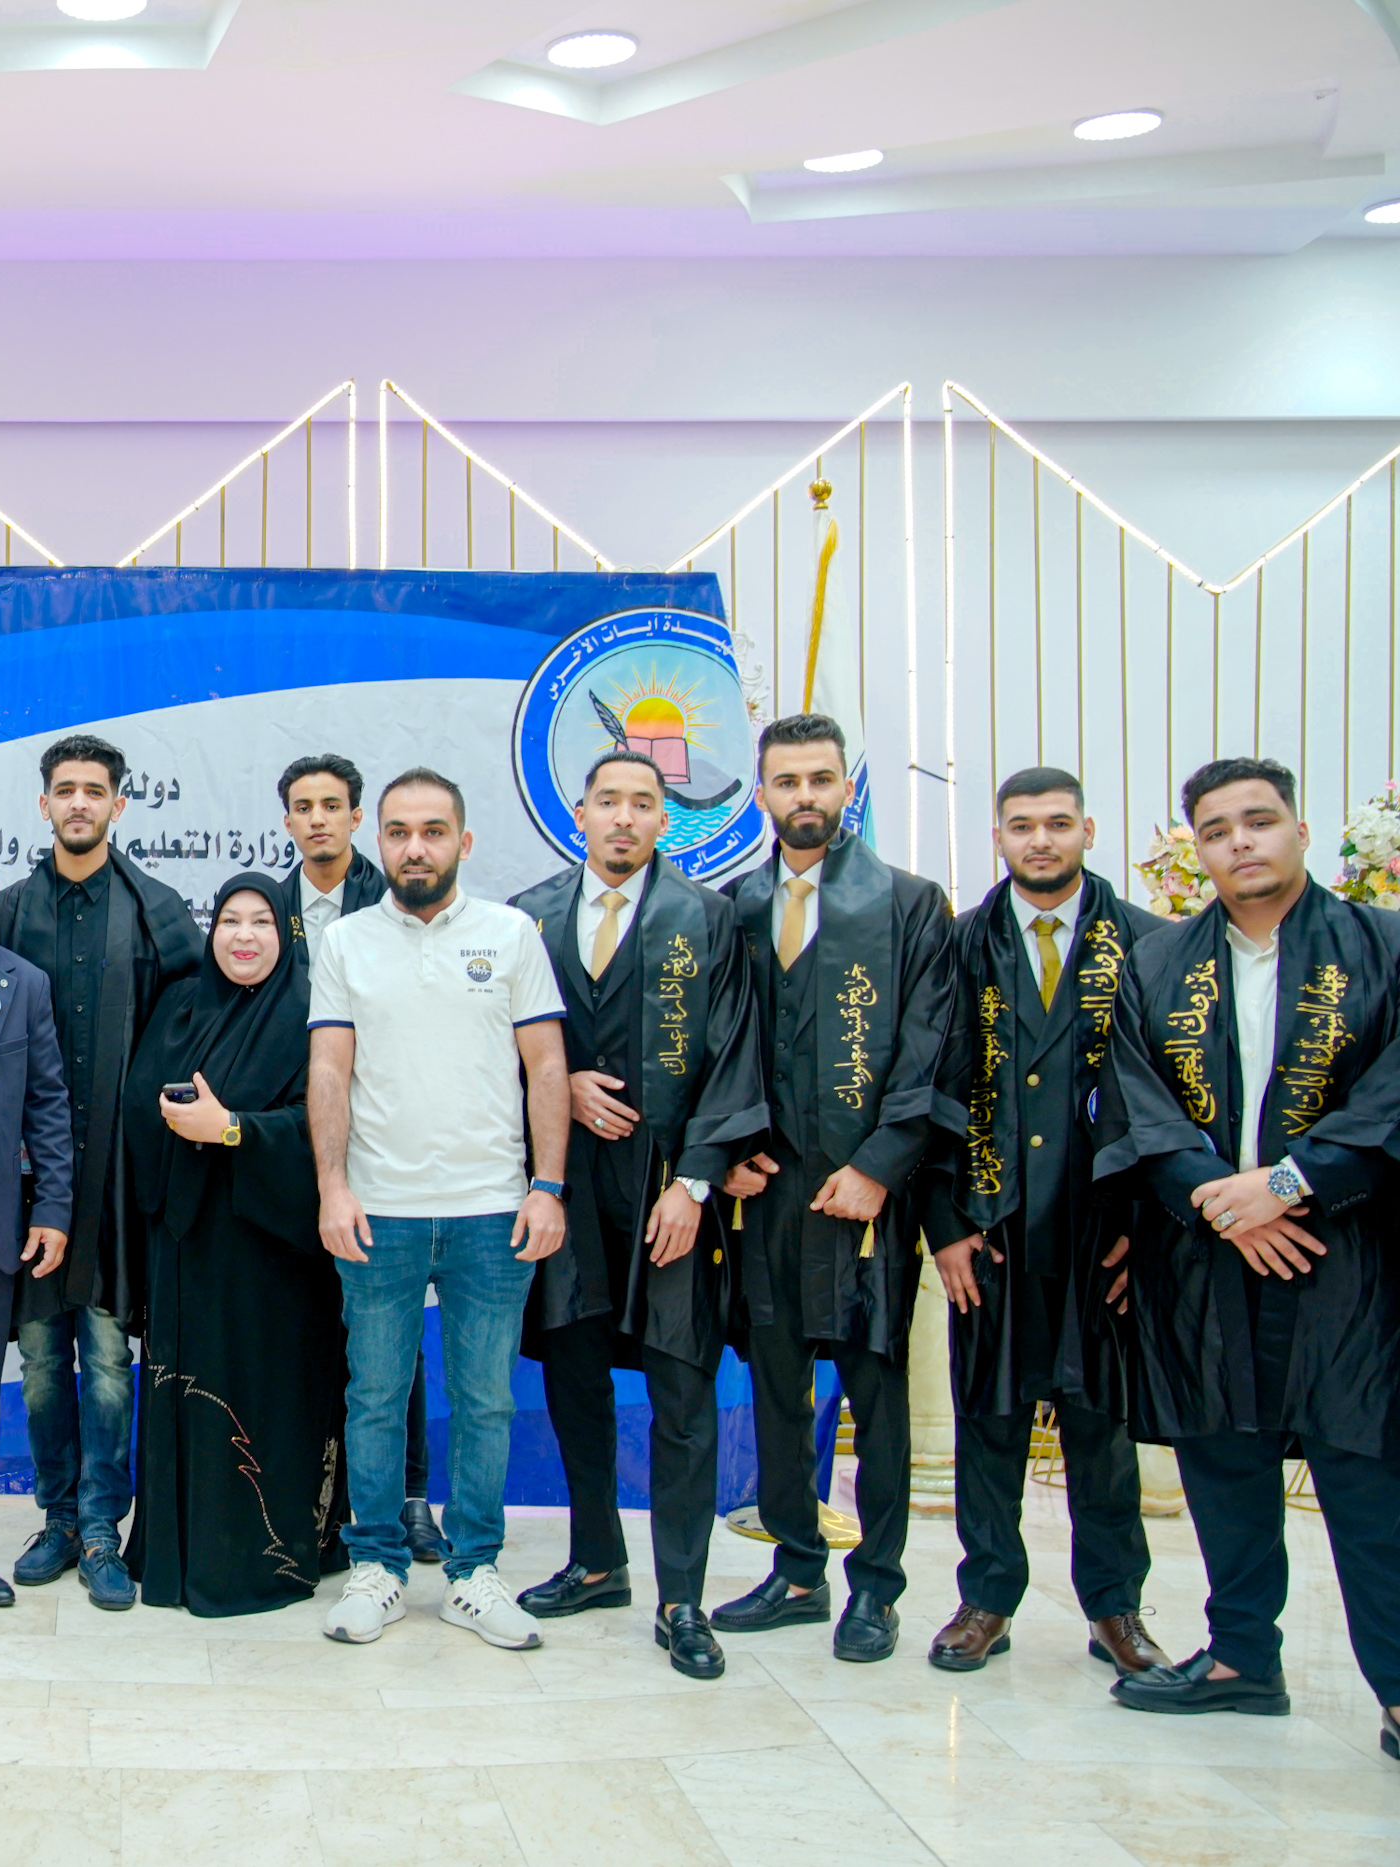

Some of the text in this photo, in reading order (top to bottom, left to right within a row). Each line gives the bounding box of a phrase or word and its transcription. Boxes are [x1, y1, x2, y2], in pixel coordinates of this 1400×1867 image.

[121, 766, 180, 809] دولة
[126, 829, 221, 869] التعليم
[228, 829, 296, 869] وزارة
[688, 829, 744, 875] العالي
[460, 949, 498, 958] BRAVERY
[662, 933, 698, 978] خريج
[1078, 919, 1125, 992] مبروك
[833, 963, 877, 1109] خريج تقنية معلومات
[1163, 959, 1220, 1124] مبروك التخرج
[1293, 1001, 1357, 1067] الشهيدة
